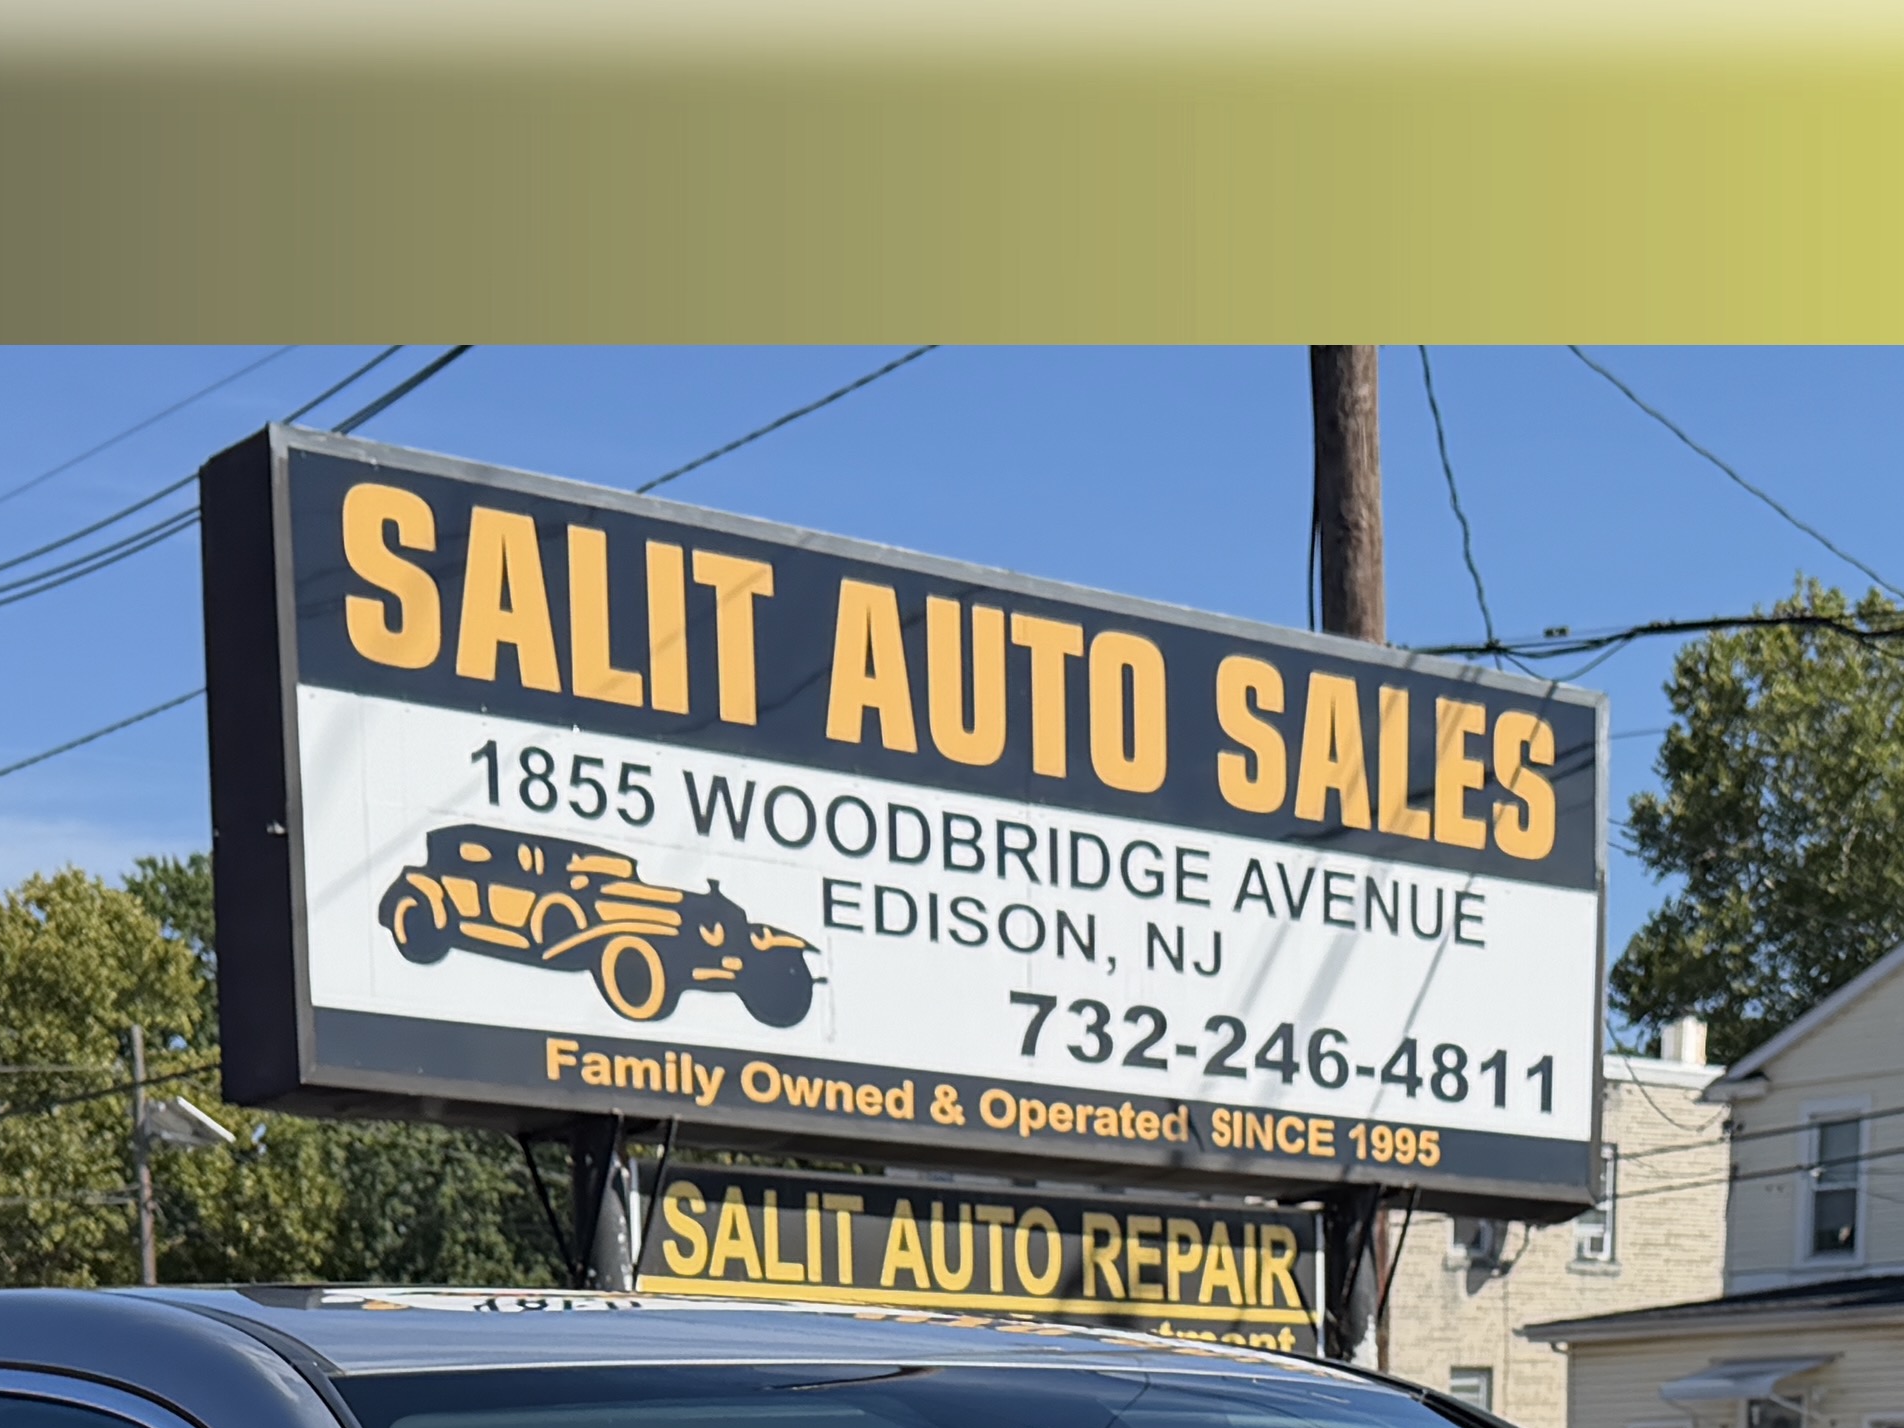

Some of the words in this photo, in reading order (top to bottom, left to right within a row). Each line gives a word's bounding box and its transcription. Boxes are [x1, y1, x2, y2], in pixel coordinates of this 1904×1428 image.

[342, 482, 775, 726] SALIT
[825, 576, 1167, 794] AUTO
[1215, 654, 1556, 861] SALES
[471, 738, 656, 827] 1855
[682, 769, 1212, 908] WOODBRIDGE
[1232, 857, 1487, 949] AVENUE
[822, 876, 1118, 976] EDISON,
[1146, 921, 1223, 978] NJ
[544, 1035, 725, 1107] Family
[740, 1060, 915, 1121] Owned
[928, 1082, 966, 1125] &
[979, 1088, 1192, 1144] Operated
[1210, 1105, 1336, 1159] SINCE
[1348, 1120, 1443, 1168] 1995
[1008, 989, 1555, 1115] 732-246-4811
[661, 1179, 865, 1285] SALIT
[880, 1195, 1063, 1298] AUTO
[1083, 1210, 1301, 1309] REPAIR
